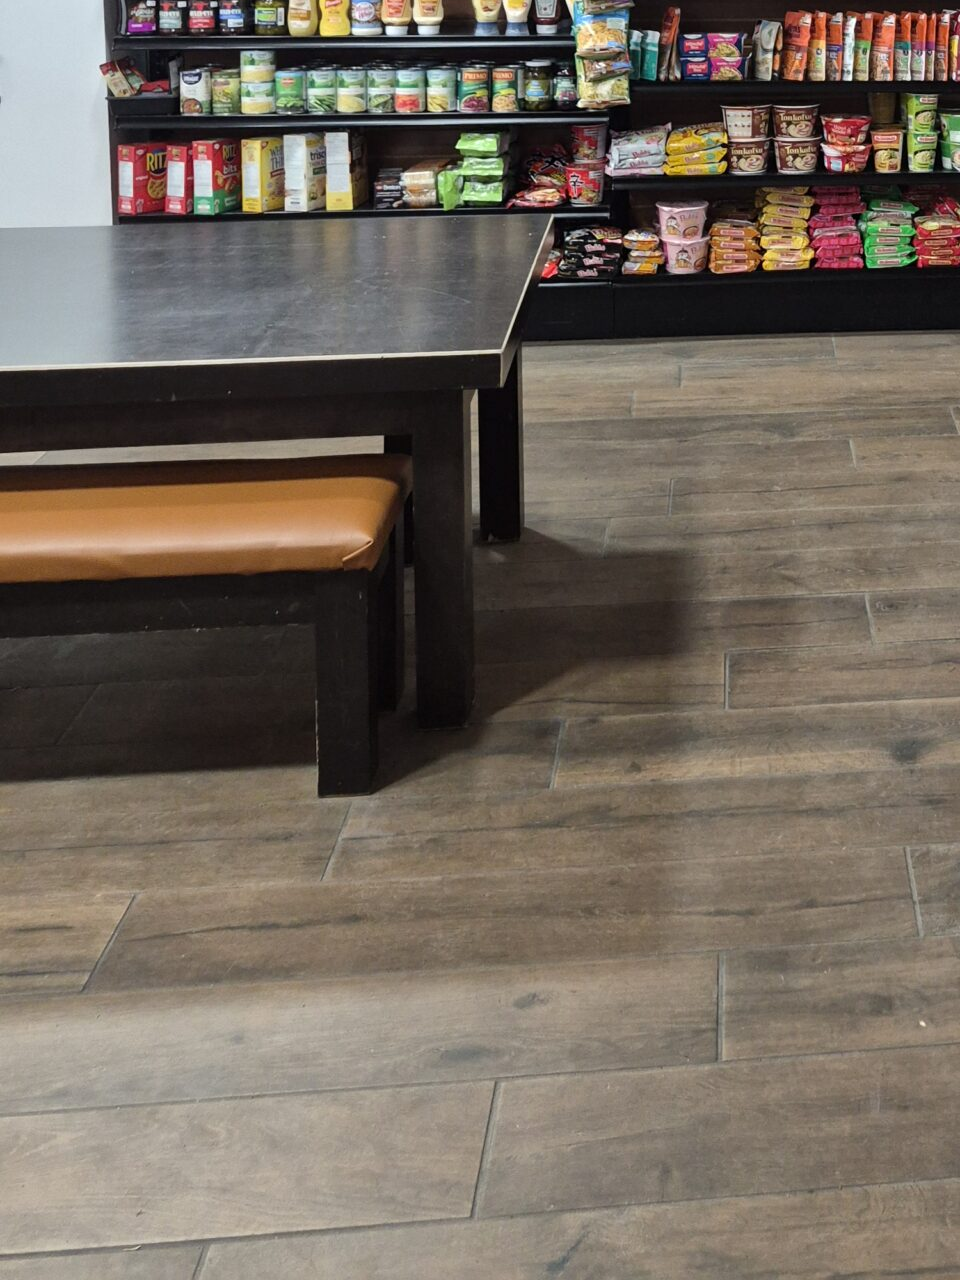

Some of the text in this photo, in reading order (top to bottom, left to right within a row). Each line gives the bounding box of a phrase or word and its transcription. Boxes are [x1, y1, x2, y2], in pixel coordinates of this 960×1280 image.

[464, 71, 488, 81] PRIMO
[222, 143, 237, 160] RITZ
[310, 151, 326, 160] trisc
[271, 158, 284, 171] THI
